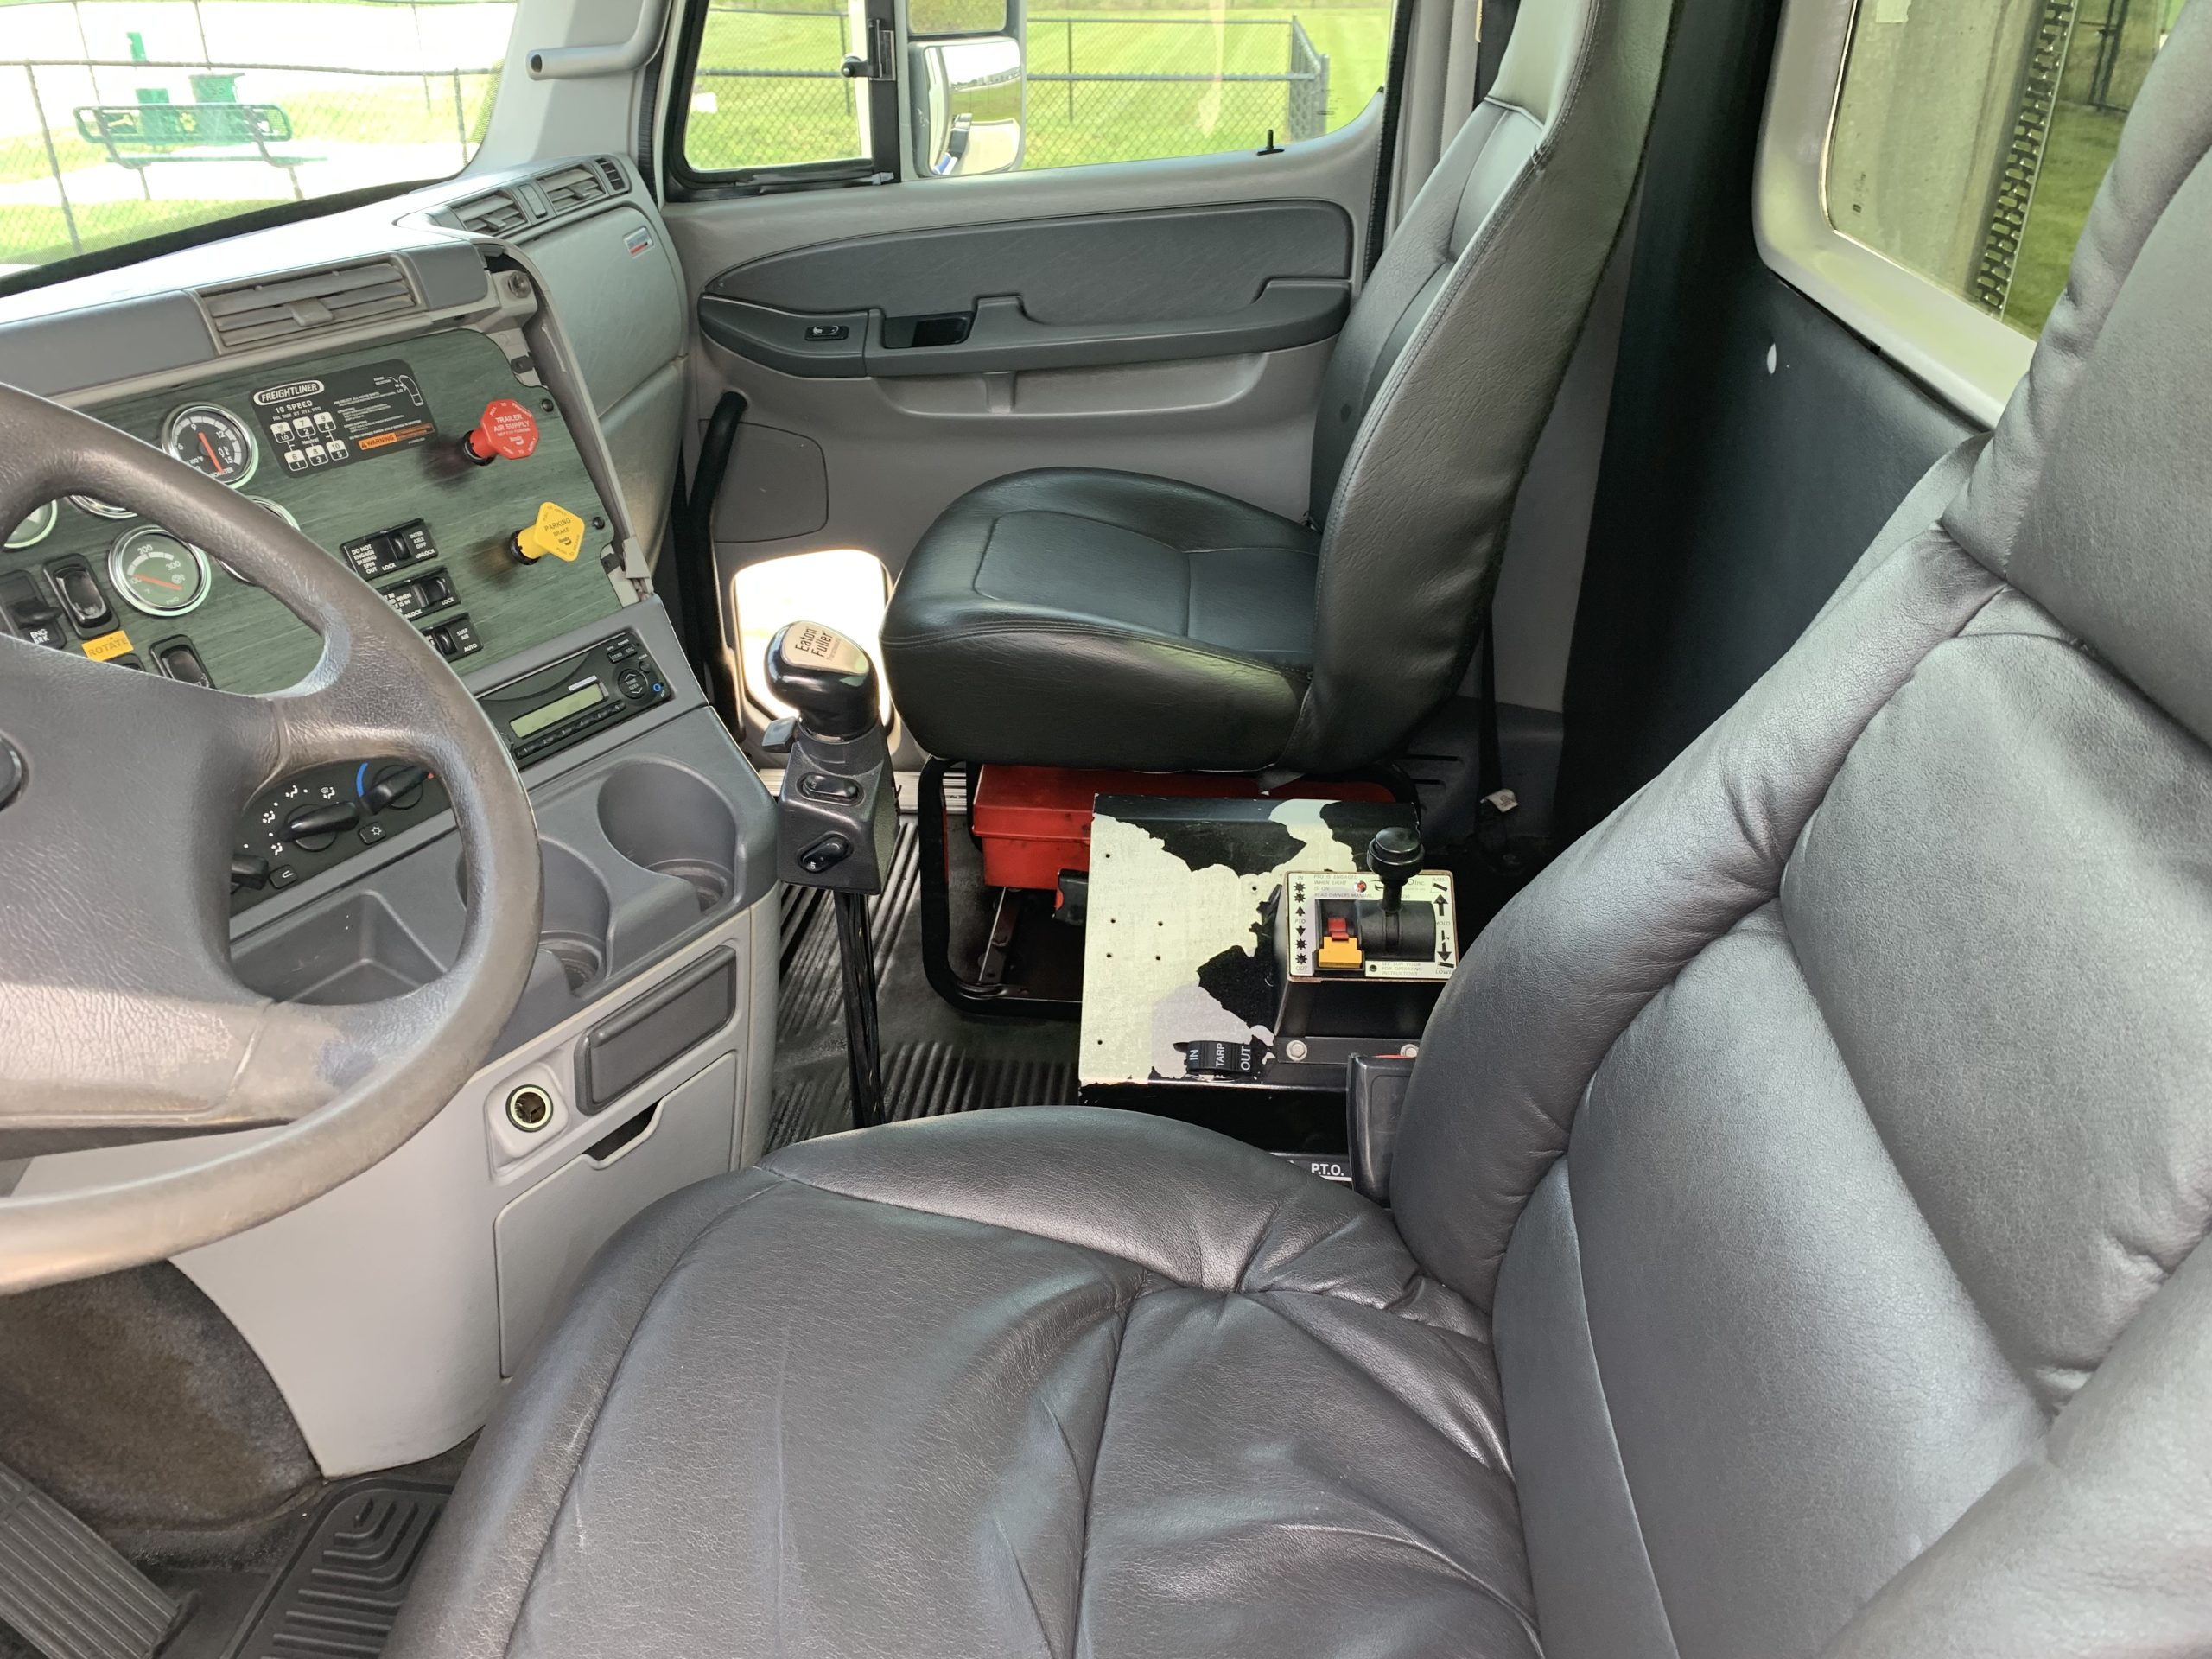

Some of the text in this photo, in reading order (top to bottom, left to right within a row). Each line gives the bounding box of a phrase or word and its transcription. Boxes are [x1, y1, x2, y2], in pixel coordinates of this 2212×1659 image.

[261, 383, 318, 403] FREIGHTLINER
[286, 400, 313, 411] SPEED
[495, 414, 523, 423] TRAILER
[505, 421, 530, 429] SUPPLY
[216, 430, 226, 439] 12
[366, 435, 394, 446] WARNING
[224, 455, 234, 464] 15
[544, 518, 571, 531] PARKING
[409, 531, 423, 539] INTER
[553, 527, 569, 537] BRAKE
[137, 544, 153, 555] 200
[416, 549, 435, 559] UNLOCK
[353, 550, 375, 560] ENGAGE
[165, 561, 181, 570] 300
[356, 555, 377, 566] DURING
[382, 563, 397, 571] LOCK
[396, 593, 412, 601] WHEN
[404, 609, 423, 619] NLOCK
[30, 628, 48, 639] ENG
[456, 628, 468, 637] SUSP
[34, 635, 50, 645] BRK
[795, 628, 817, 652] Eaton
[811, 632, 833, 658] Fuller
[88, 637, 129, 657] ROTATE
[464, 643, 477, 652] AUTO
[1189, 1049, 1199, 1061] IN
[1216, 1043, 1225, 1067] TARP
[1240, 1046, 1251, 1071] OUT
[1311, 1163, 1344, 1176] P.T.O.
